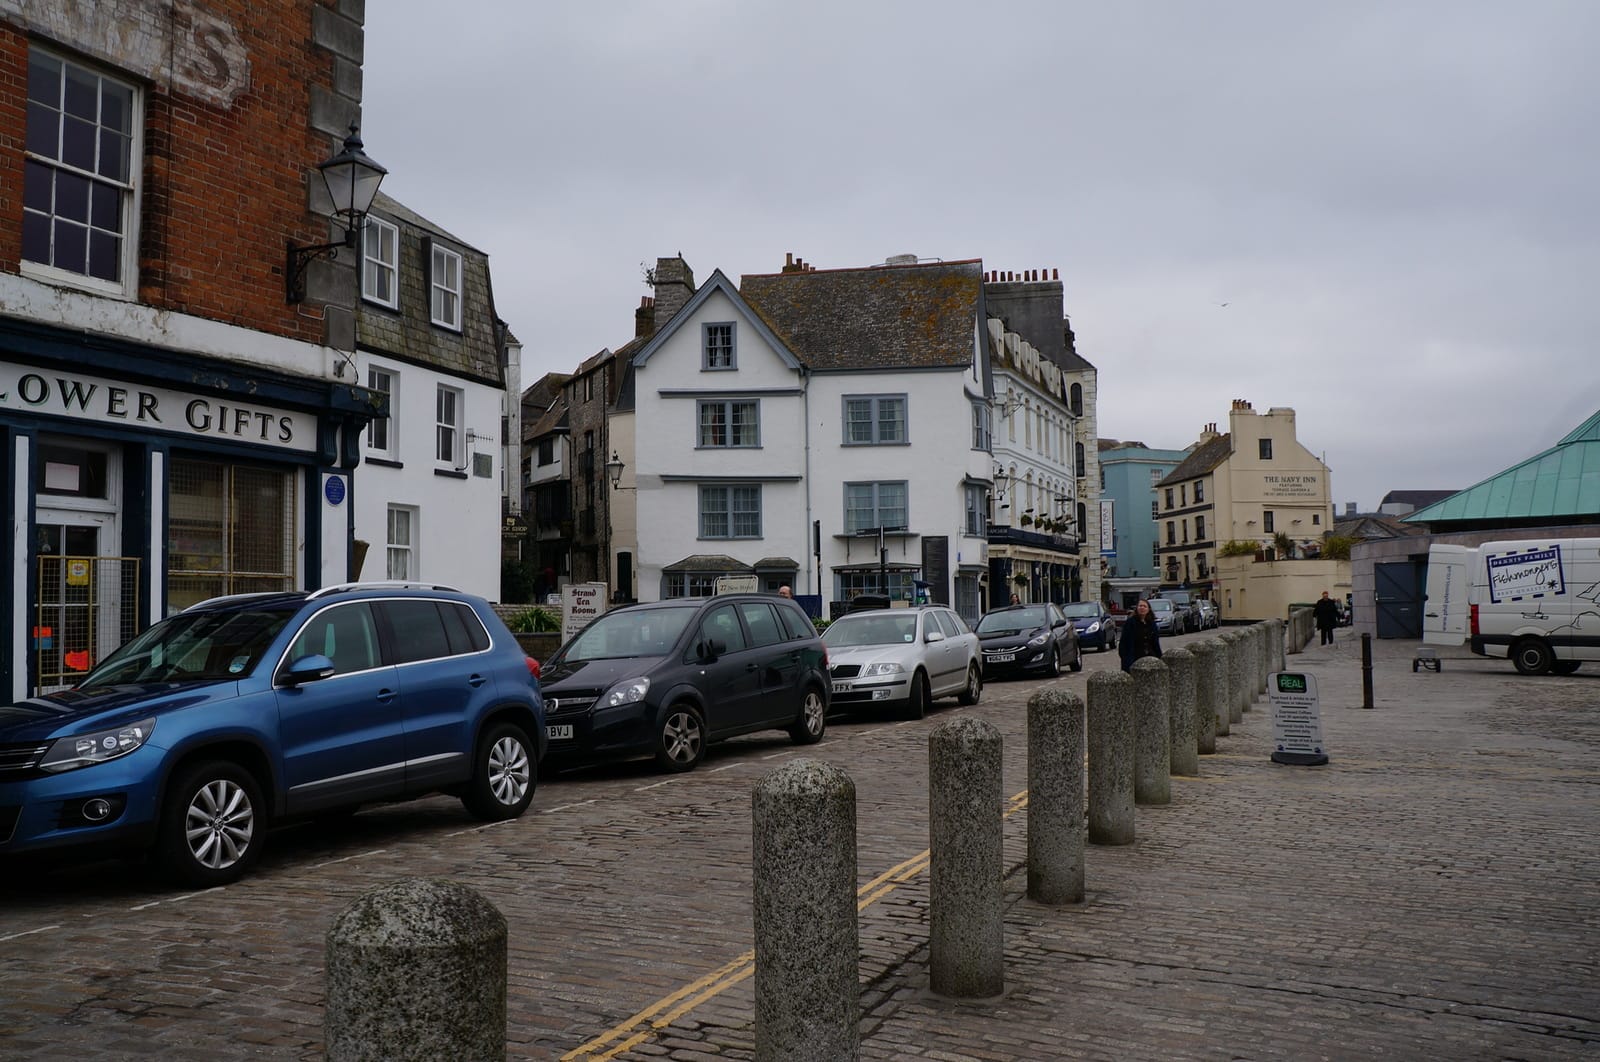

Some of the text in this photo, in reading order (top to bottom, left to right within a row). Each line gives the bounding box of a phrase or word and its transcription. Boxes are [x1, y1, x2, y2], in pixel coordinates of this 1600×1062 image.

[184, 398, 295, 443] GIFTS
[1263, 475, 1317, 483] THE NAVY INN
[1524, 552, 1554, 561] FAMILY
[1493, 560, 1558, 588] Fishmongers
[571, 588, 597, 597] Strand
[571, 606, 597, 614] Rooms
[1280, 679, 1304, 688] REAL
[550, 726, 569, 737] BVJ
